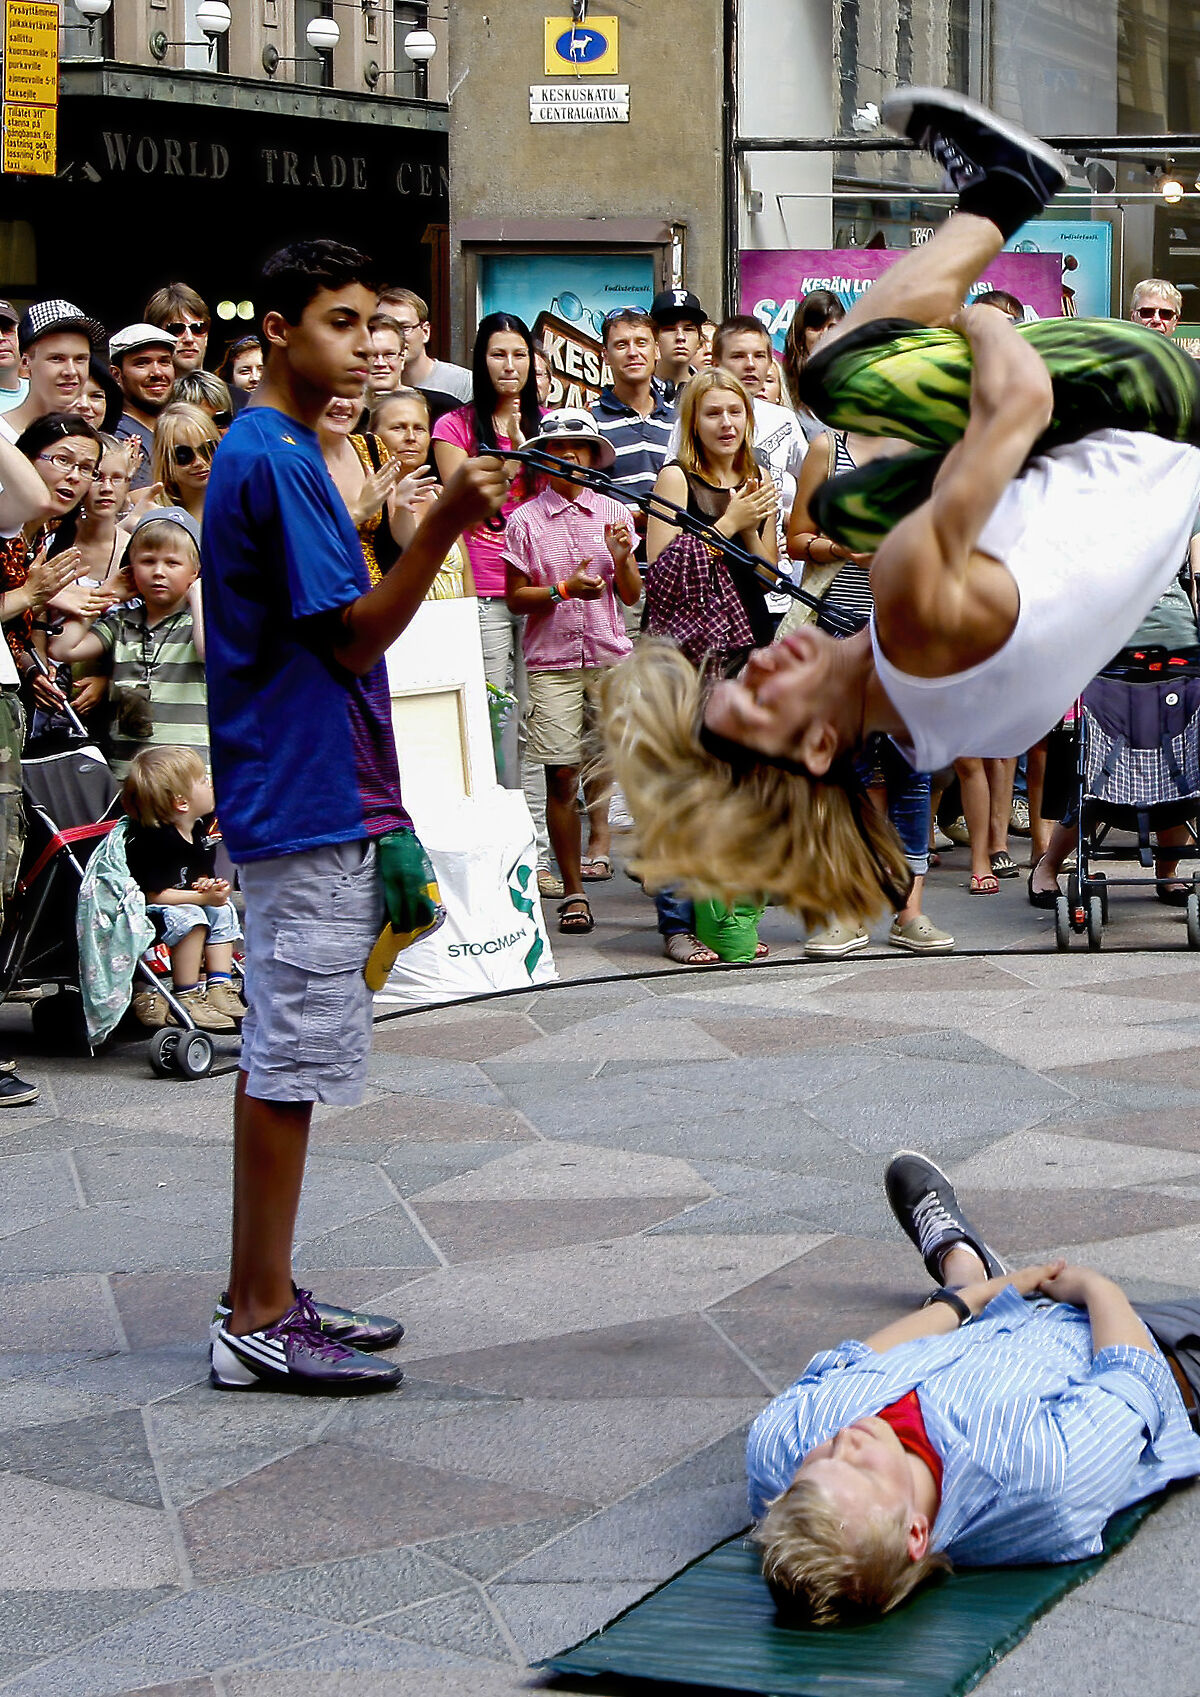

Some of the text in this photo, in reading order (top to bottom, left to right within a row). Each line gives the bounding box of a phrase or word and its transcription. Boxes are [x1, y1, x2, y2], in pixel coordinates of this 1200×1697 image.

[541, 88, 616, 102] KESKUSKATU
[540, 107, 619, 120] CENTRALGATAN
[103, 131, 230, 180] WORLD
[261, 149, 368, 190] TRADE
[854, 279, 877, 293] LO
[672, 290, 688, 307] F
